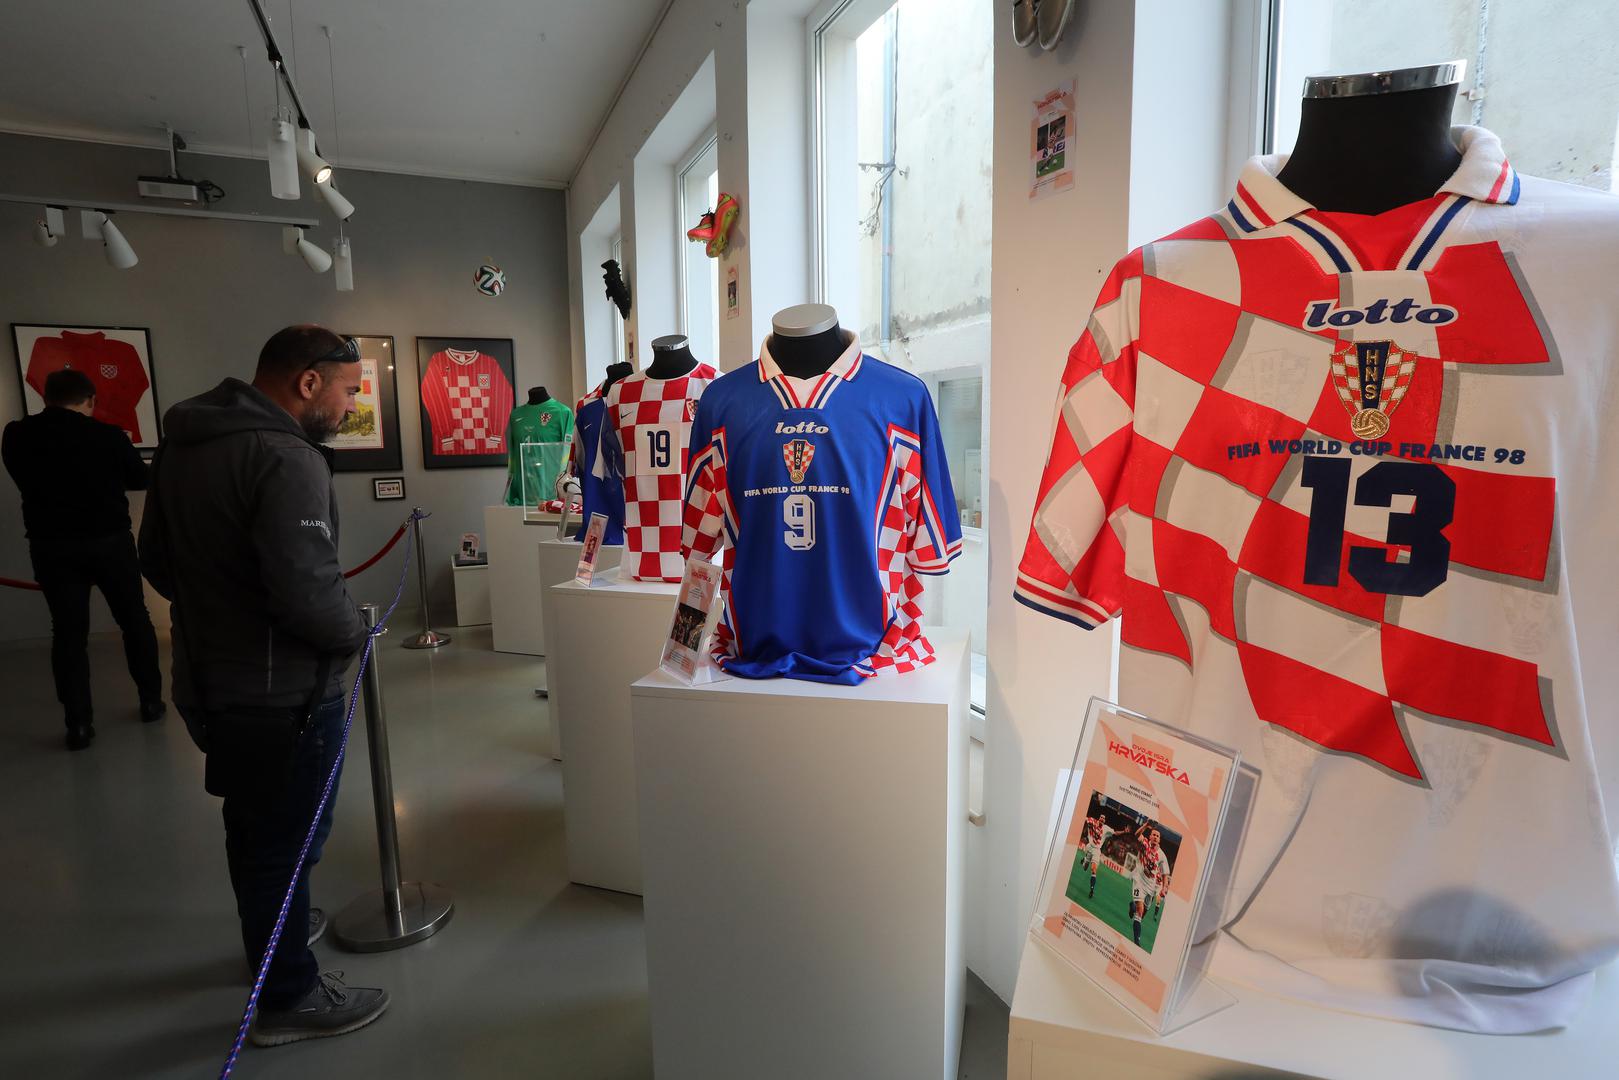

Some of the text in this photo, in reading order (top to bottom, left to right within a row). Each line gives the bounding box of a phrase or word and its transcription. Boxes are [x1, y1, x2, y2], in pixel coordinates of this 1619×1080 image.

[1304, 298, 1457, 330] lotto
[1365, 349, 1379, 400] HNS
[775, 421, 829, 434] lotto
[647, 430, 671, 468] 19
[1228, 439, 1526, 465] FIFA WORLD CUP FRANCE 98
[744, 485, 850, 497] FIFA WORLD CUP FRANCE 98
[783, 494, 816, 550] 9
[1300, 455, 1456, 598] 13
[1109, 741, 1190, 786] HRVATSKA
